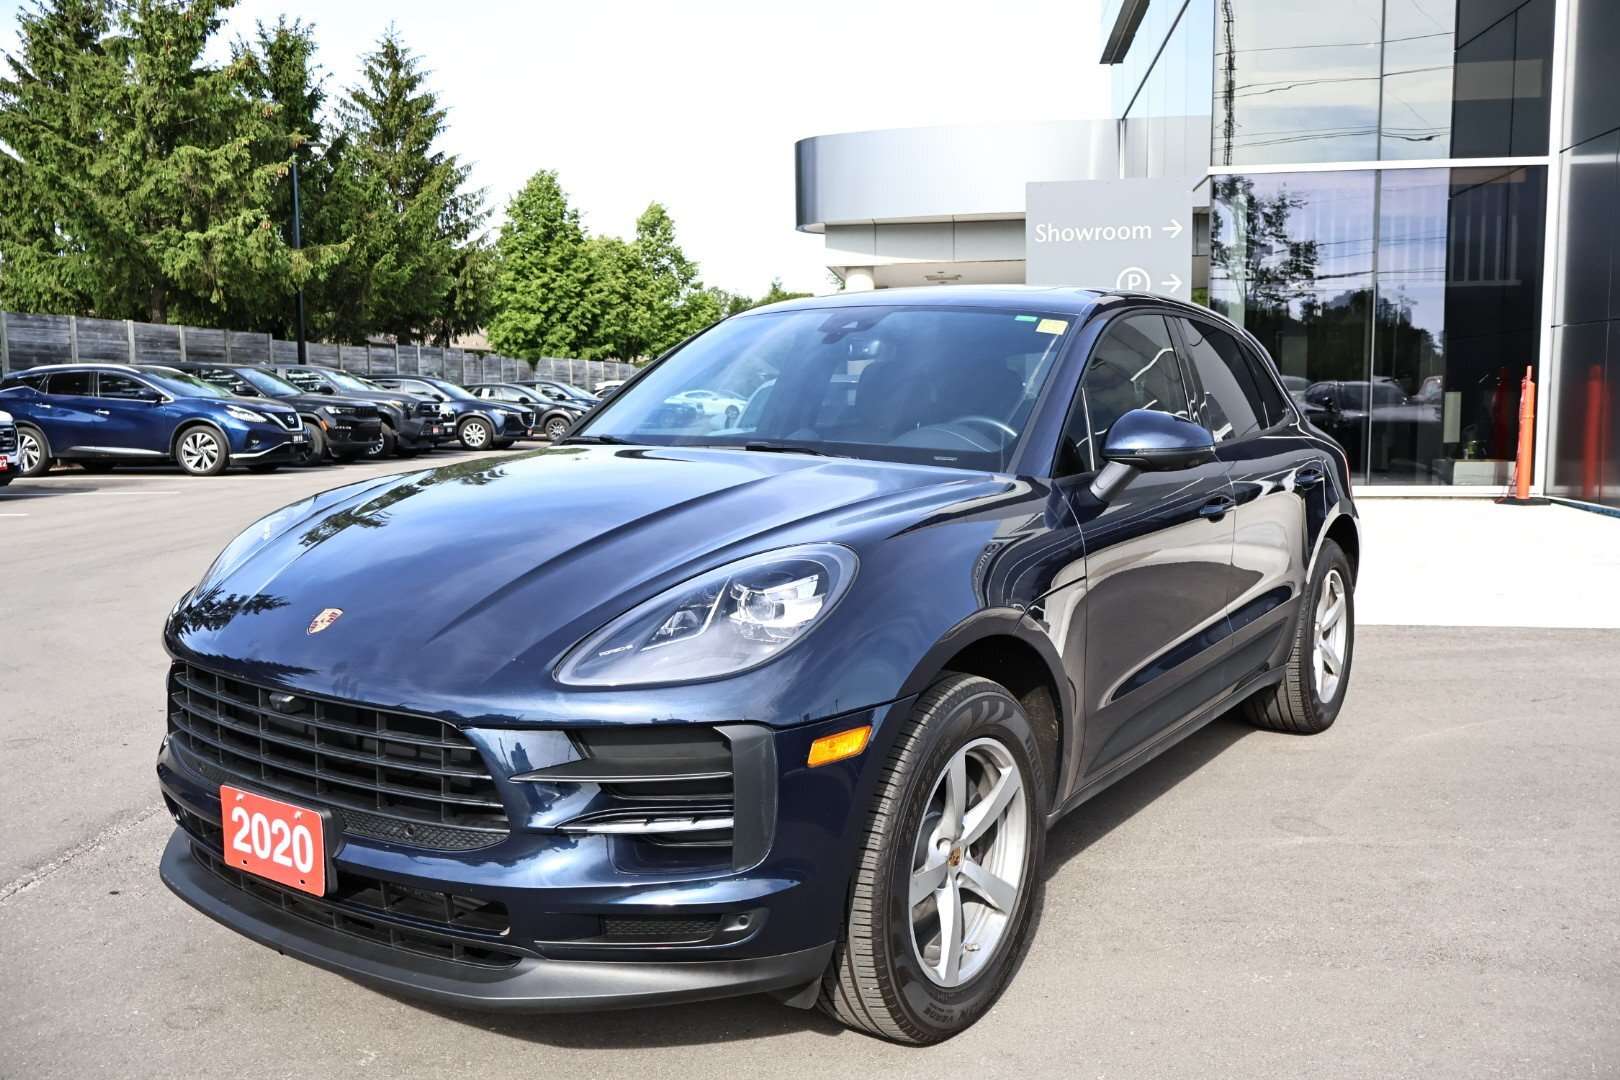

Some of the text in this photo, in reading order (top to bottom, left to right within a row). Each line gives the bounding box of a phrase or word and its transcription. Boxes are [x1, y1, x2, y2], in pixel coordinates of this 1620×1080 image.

[1035, 223, 1152, 242] Showroom
[1127, 274, 1141, 291] P
[231, 806, 314, 873] 2020
